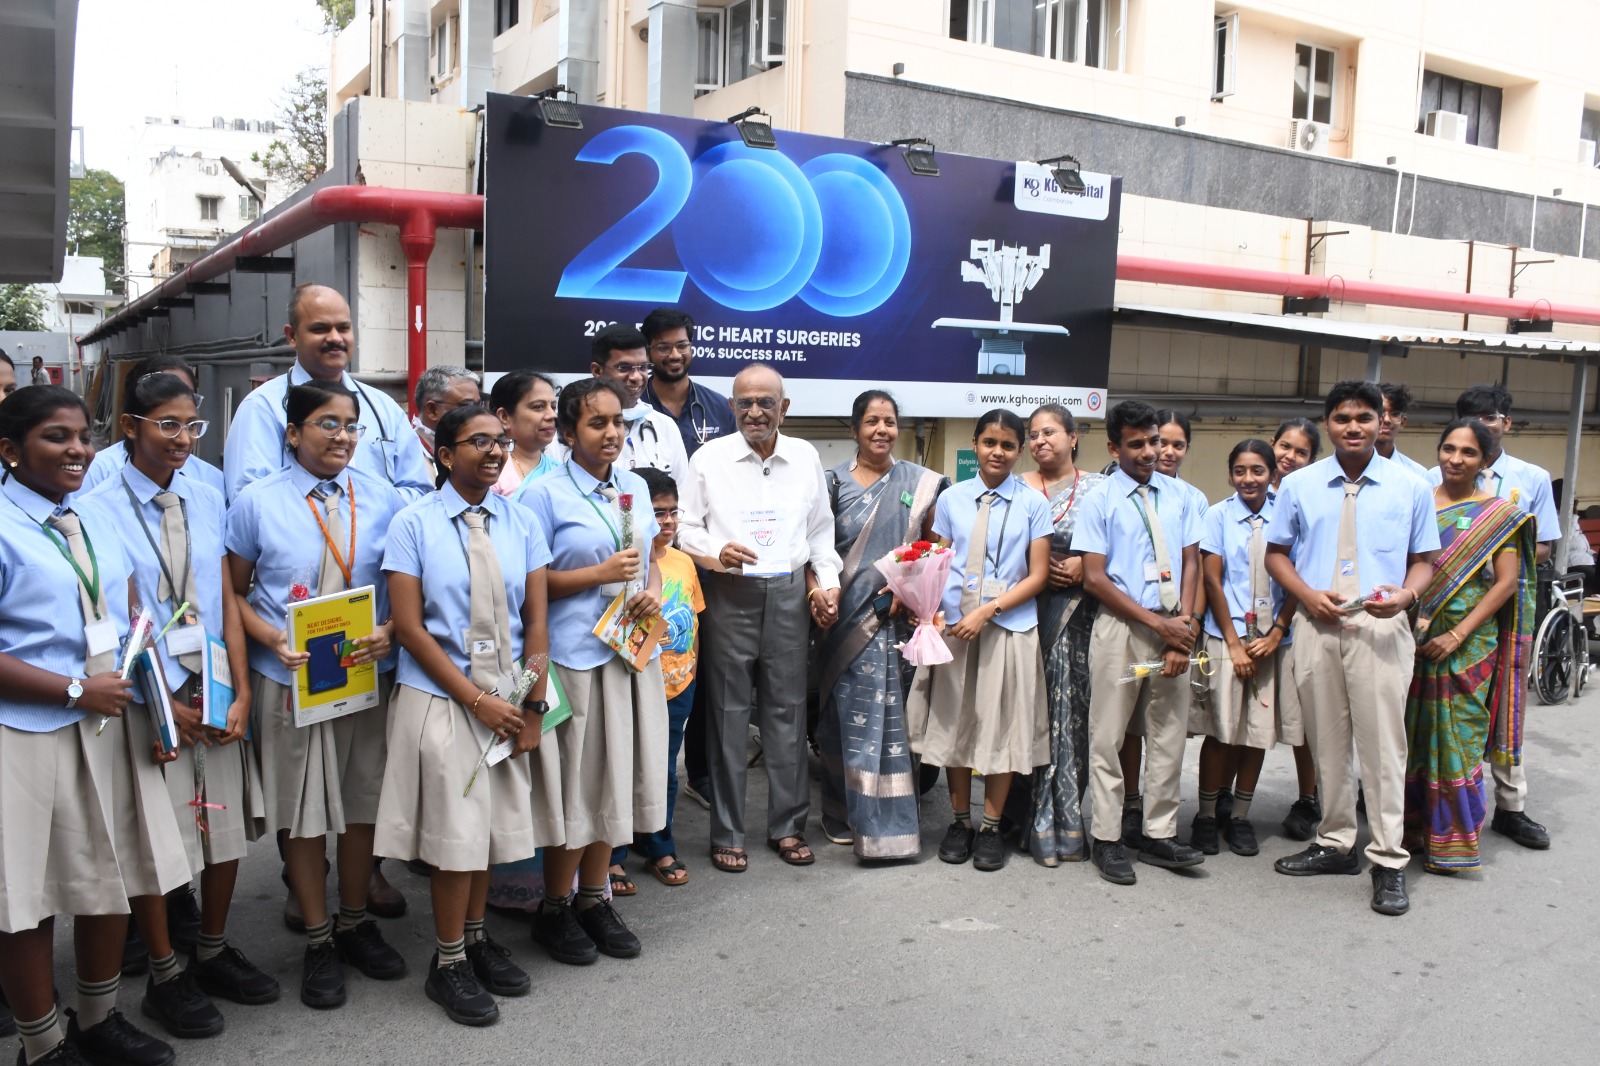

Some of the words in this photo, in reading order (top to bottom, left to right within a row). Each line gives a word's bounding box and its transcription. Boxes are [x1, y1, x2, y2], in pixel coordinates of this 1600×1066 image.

[1044, 177, 1058, 193] KG
[1061, 182, 1104, 199] ital
[555, 125, 912, 318] 200
[718, 327, 774, 344] HEART
[776, 330, 861, 347] SURGERIES
[691, 346, 715, 359] 00%
[718, 348, 772, 360] SUCCESS
[774, 350, 807, 362] RATE.
[980, 394, 1082, 407] www.kghospital.com
